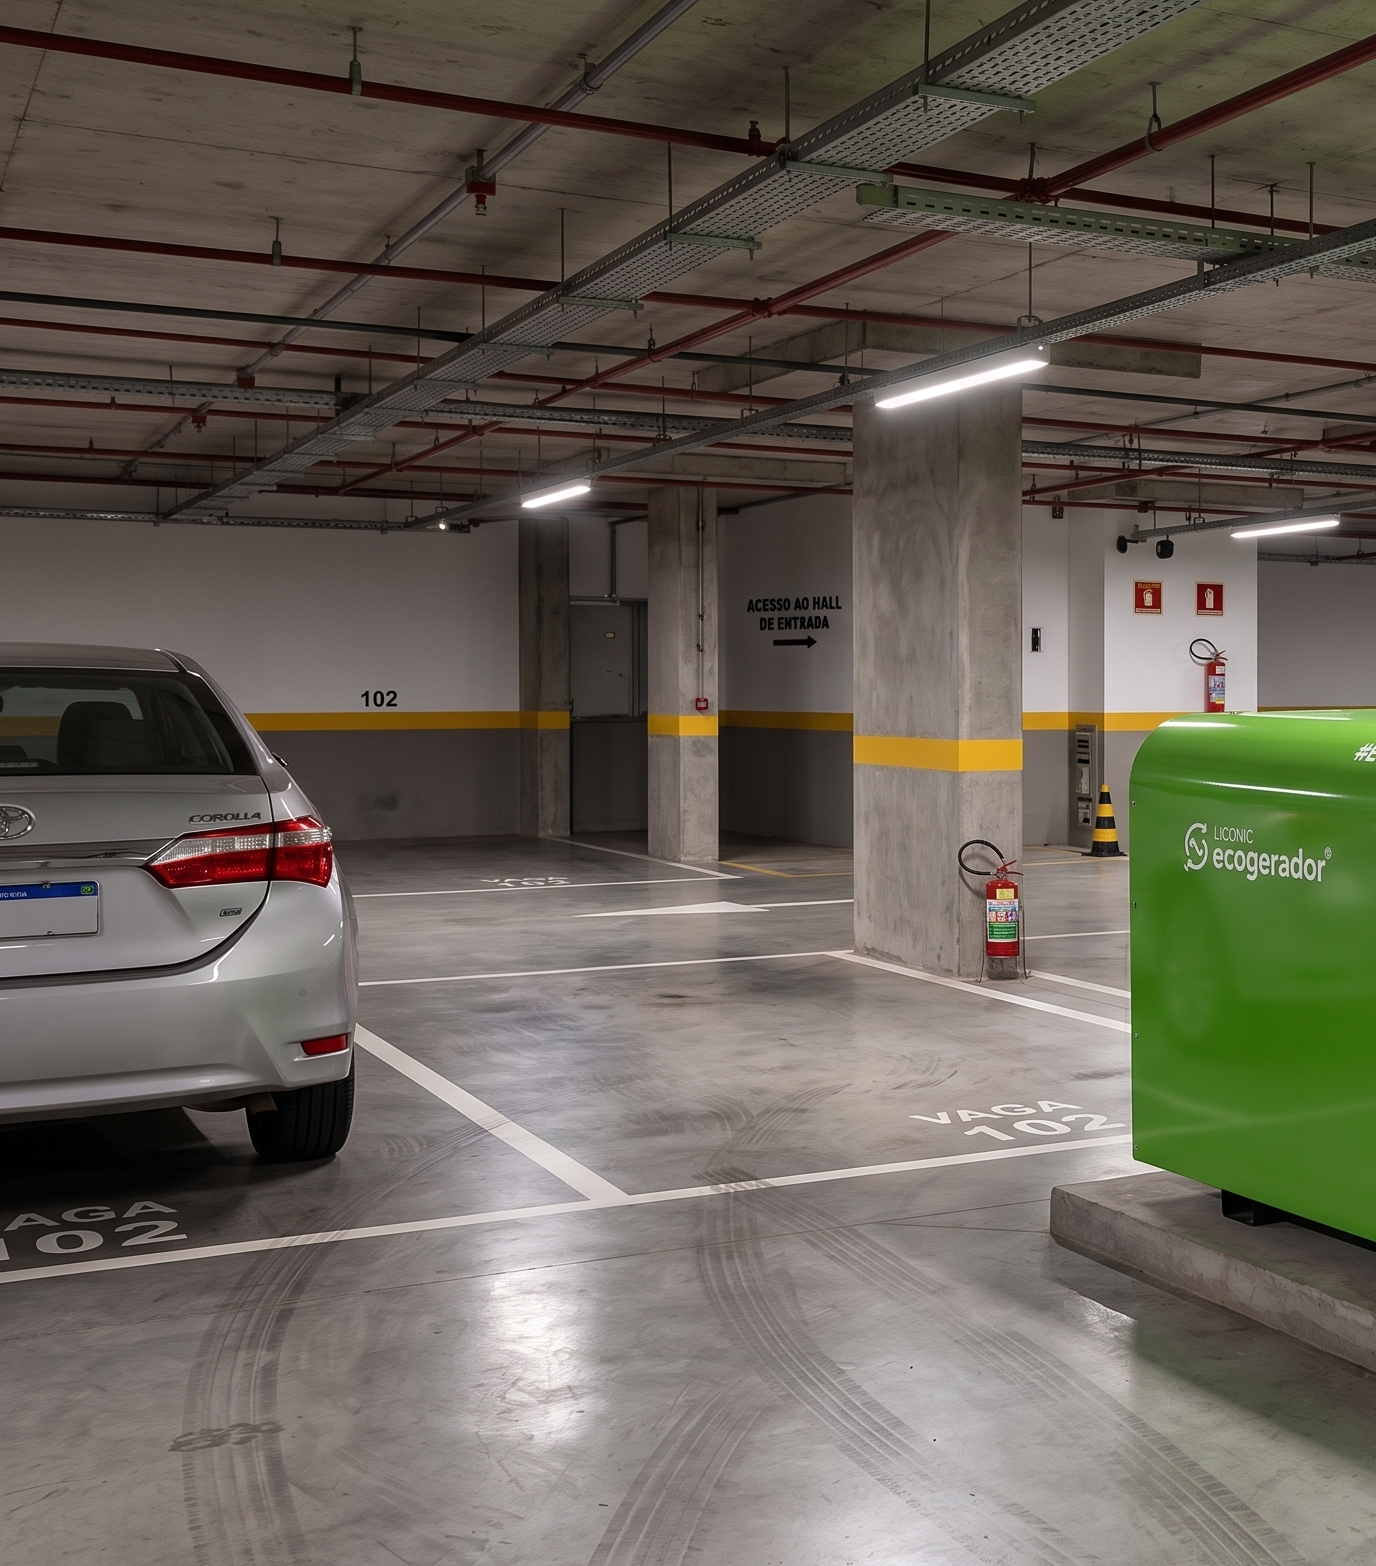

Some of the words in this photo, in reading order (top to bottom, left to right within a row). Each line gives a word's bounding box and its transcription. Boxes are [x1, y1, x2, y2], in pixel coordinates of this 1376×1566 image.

[746, 597, 791, 613] ACESSO
[793, 596, 810, 611] AO
[812, 595, 842, 611] HALL
[759, 616, 775, 631] DE
[777, 615, 830, 631] ENTRADA
[360, 690, 398, 708] 102
[188, 812, 262, 823] COROLLA
[1213, 825, 1254, 844] LICONIC
[908, 1100, 1084, 1125] VAGA
[963, 1113, 1127, 1141] 102
[0, 1200, 178, 1232] AGA
